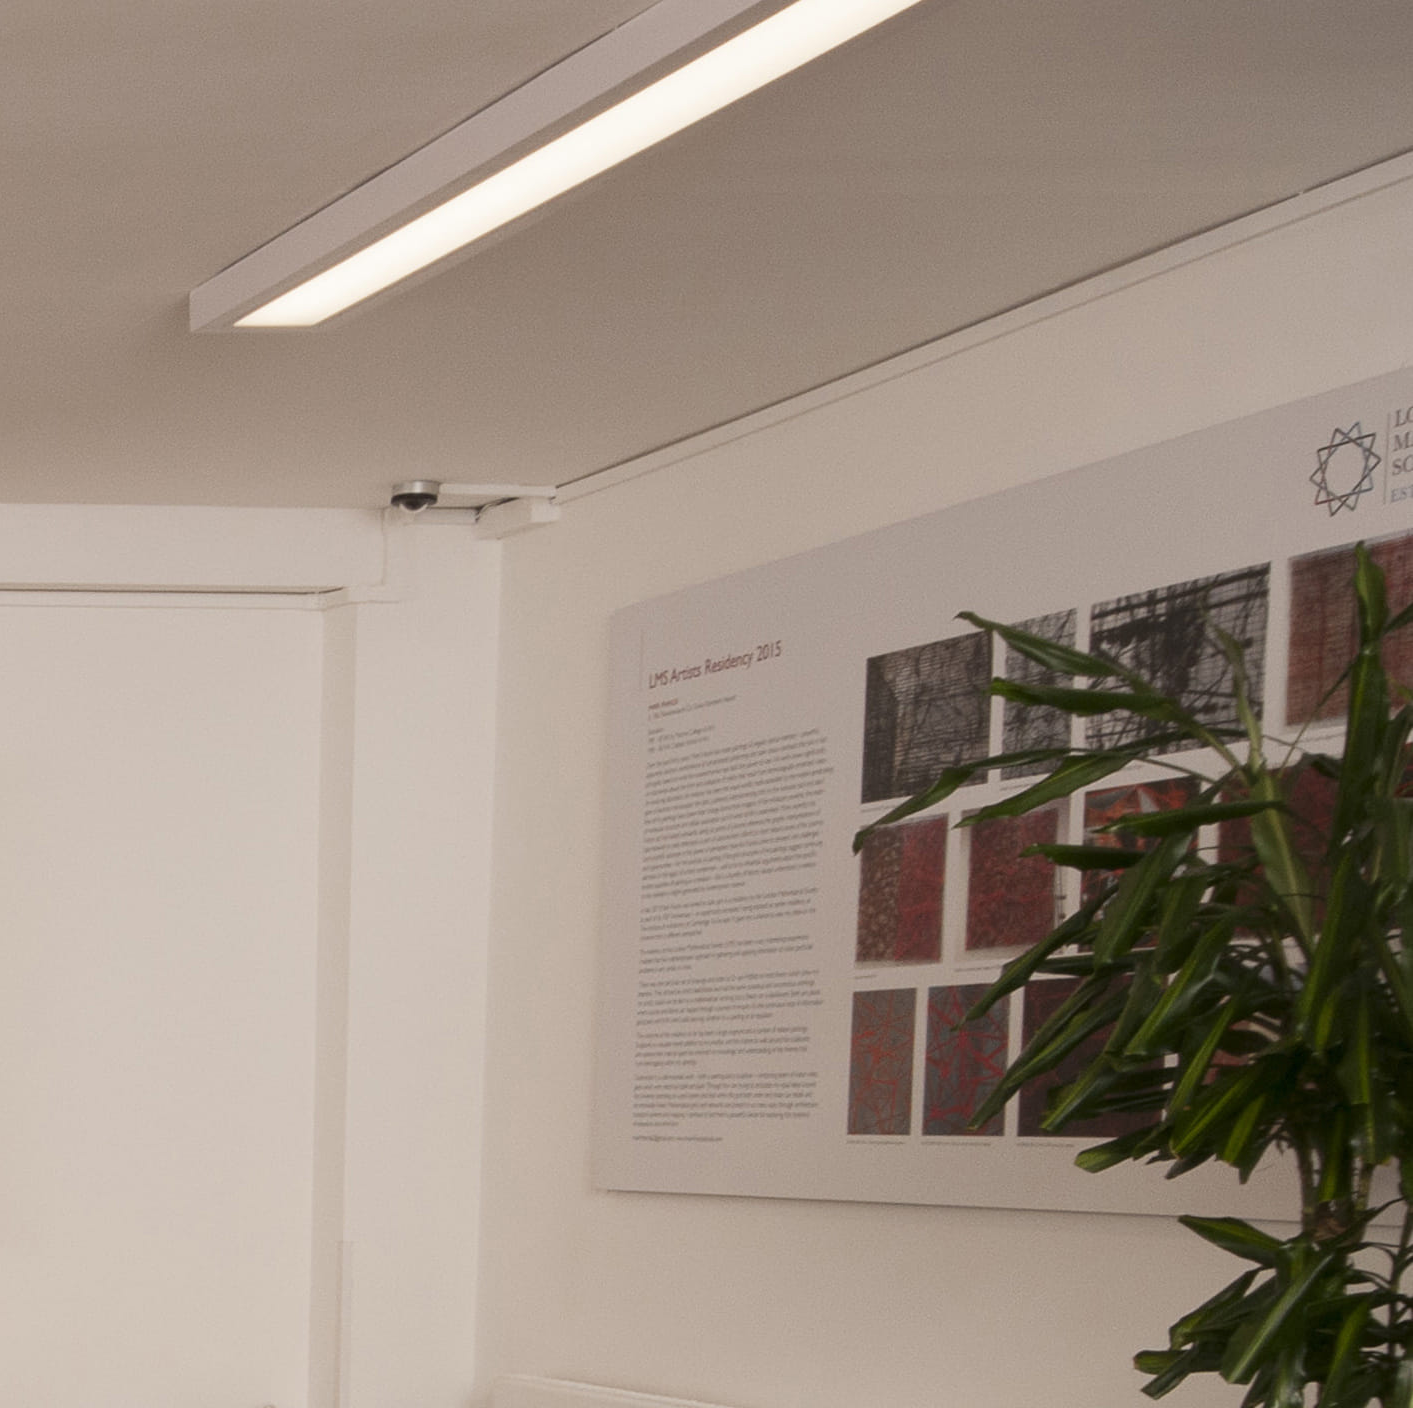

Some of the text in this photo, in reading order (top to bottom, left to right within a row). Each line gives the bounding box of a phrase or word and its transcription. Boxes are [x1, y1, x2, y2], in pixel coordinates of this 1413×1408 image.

[1392, 431, 1413, 452] M
[649, 640, 782, 689] LMS Artists Residency 2015
